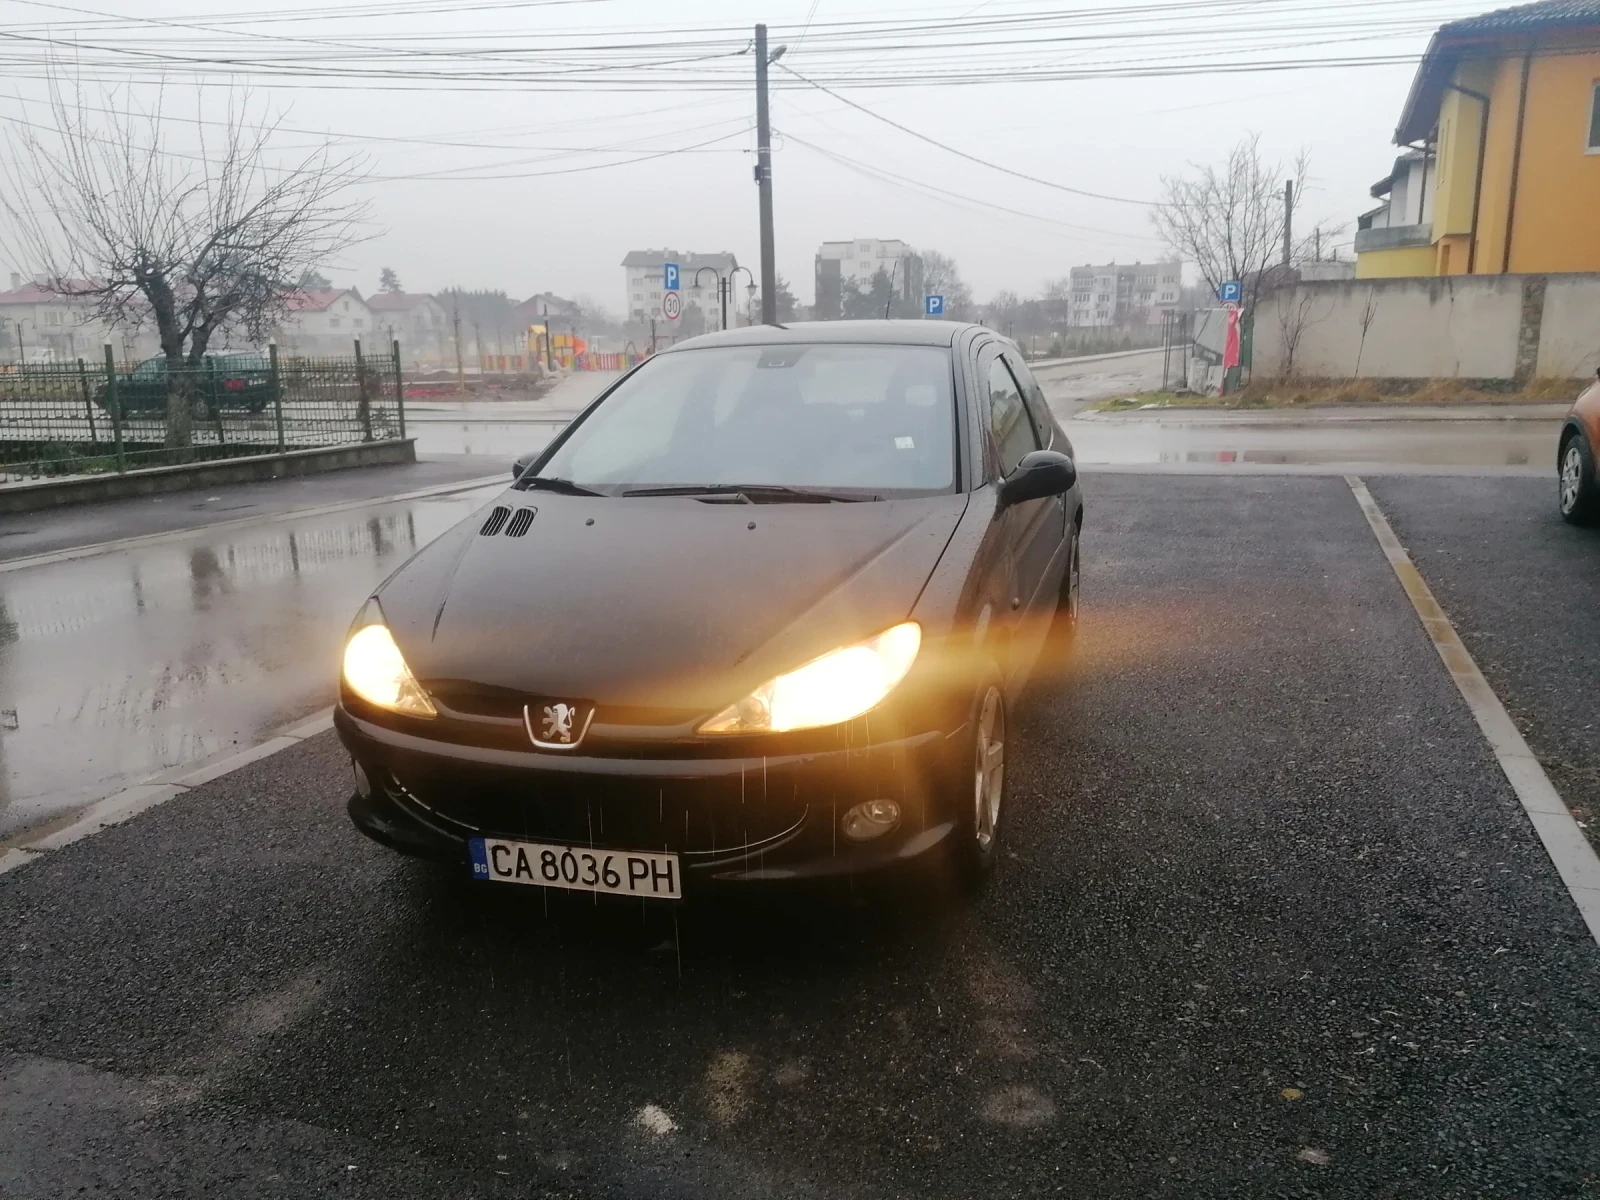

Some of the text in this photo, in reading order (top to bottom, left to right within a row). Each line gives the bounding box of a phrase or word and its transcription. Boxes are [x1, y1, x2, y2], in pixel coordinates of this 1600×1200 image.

[667, 266, 677, 287] P
[1225, 284, 1236, 299] P
[667, 298, 678, 314] 30
[929, 297, 940, 313] P
[474, 862, 488, 874] BG
[491, 845, 675, 893] CA 8036 PH
